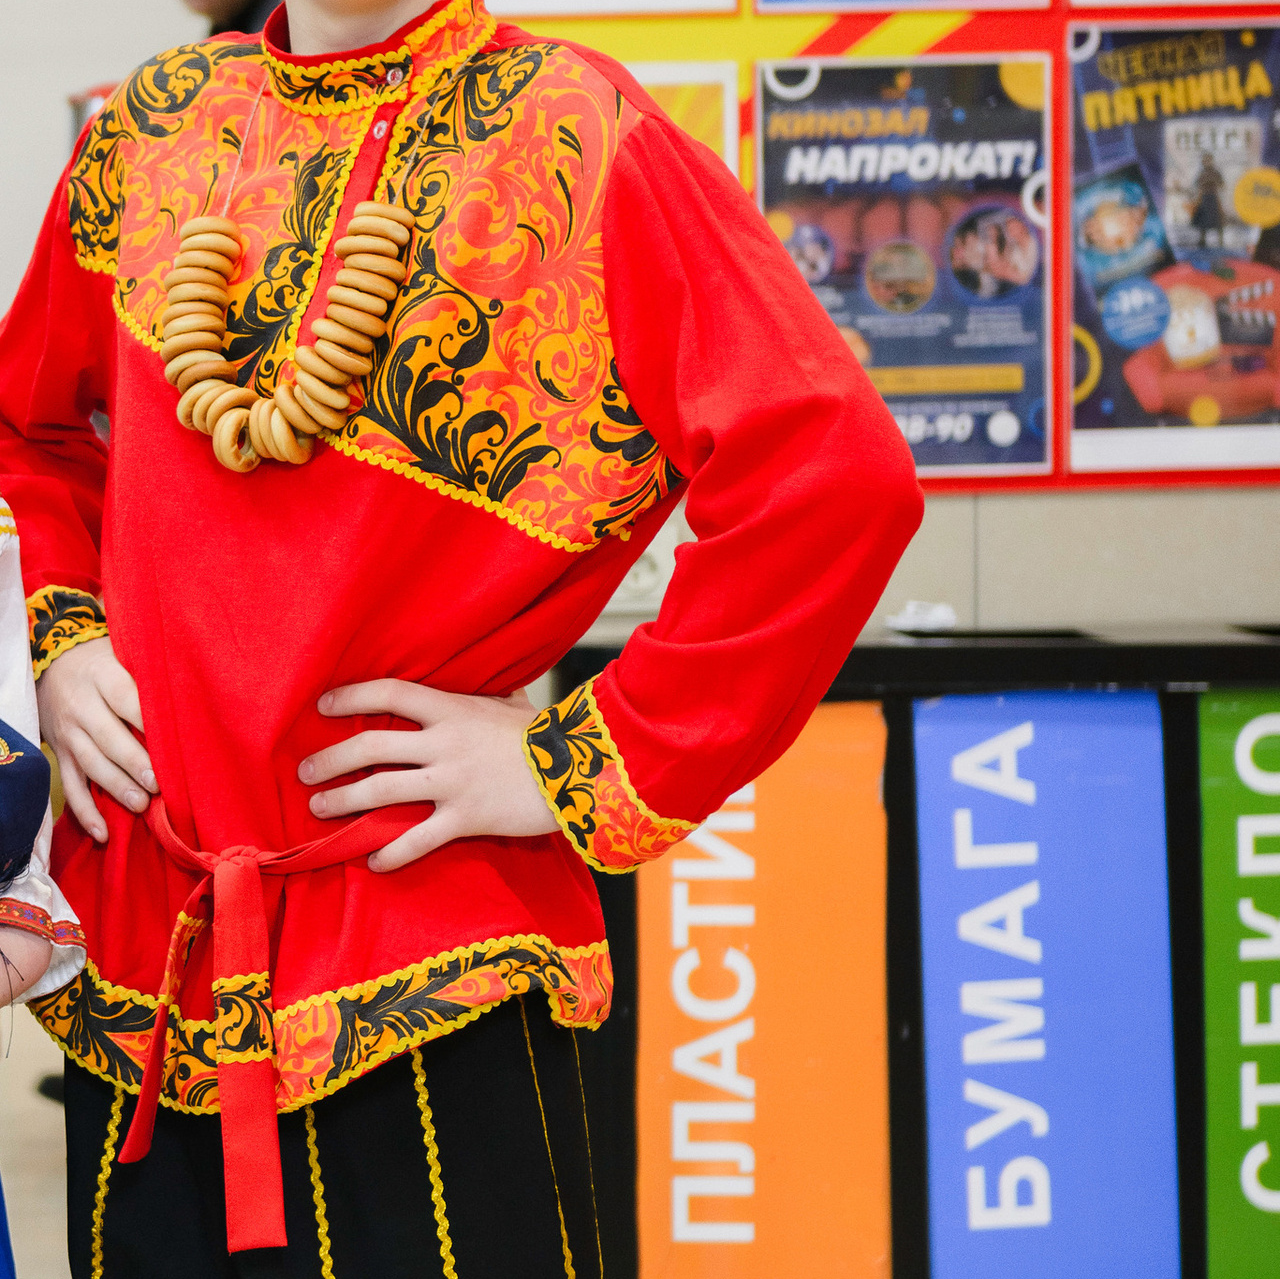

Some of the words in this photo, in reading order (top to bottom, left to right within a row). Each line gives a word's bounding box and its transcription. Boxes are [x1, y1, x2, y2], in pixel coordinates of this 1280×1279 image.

[768, 107, 929, 139] КИНОЗАЛ
[1083, 60, 1273, 132] ПЯТНИЦА
[785, 140, 1037, 183] НАПРОКАТ!
[951, 720, 1053, 1232] БУМАГА
[671, 782, 756, 1243] ПЛАСТИ
